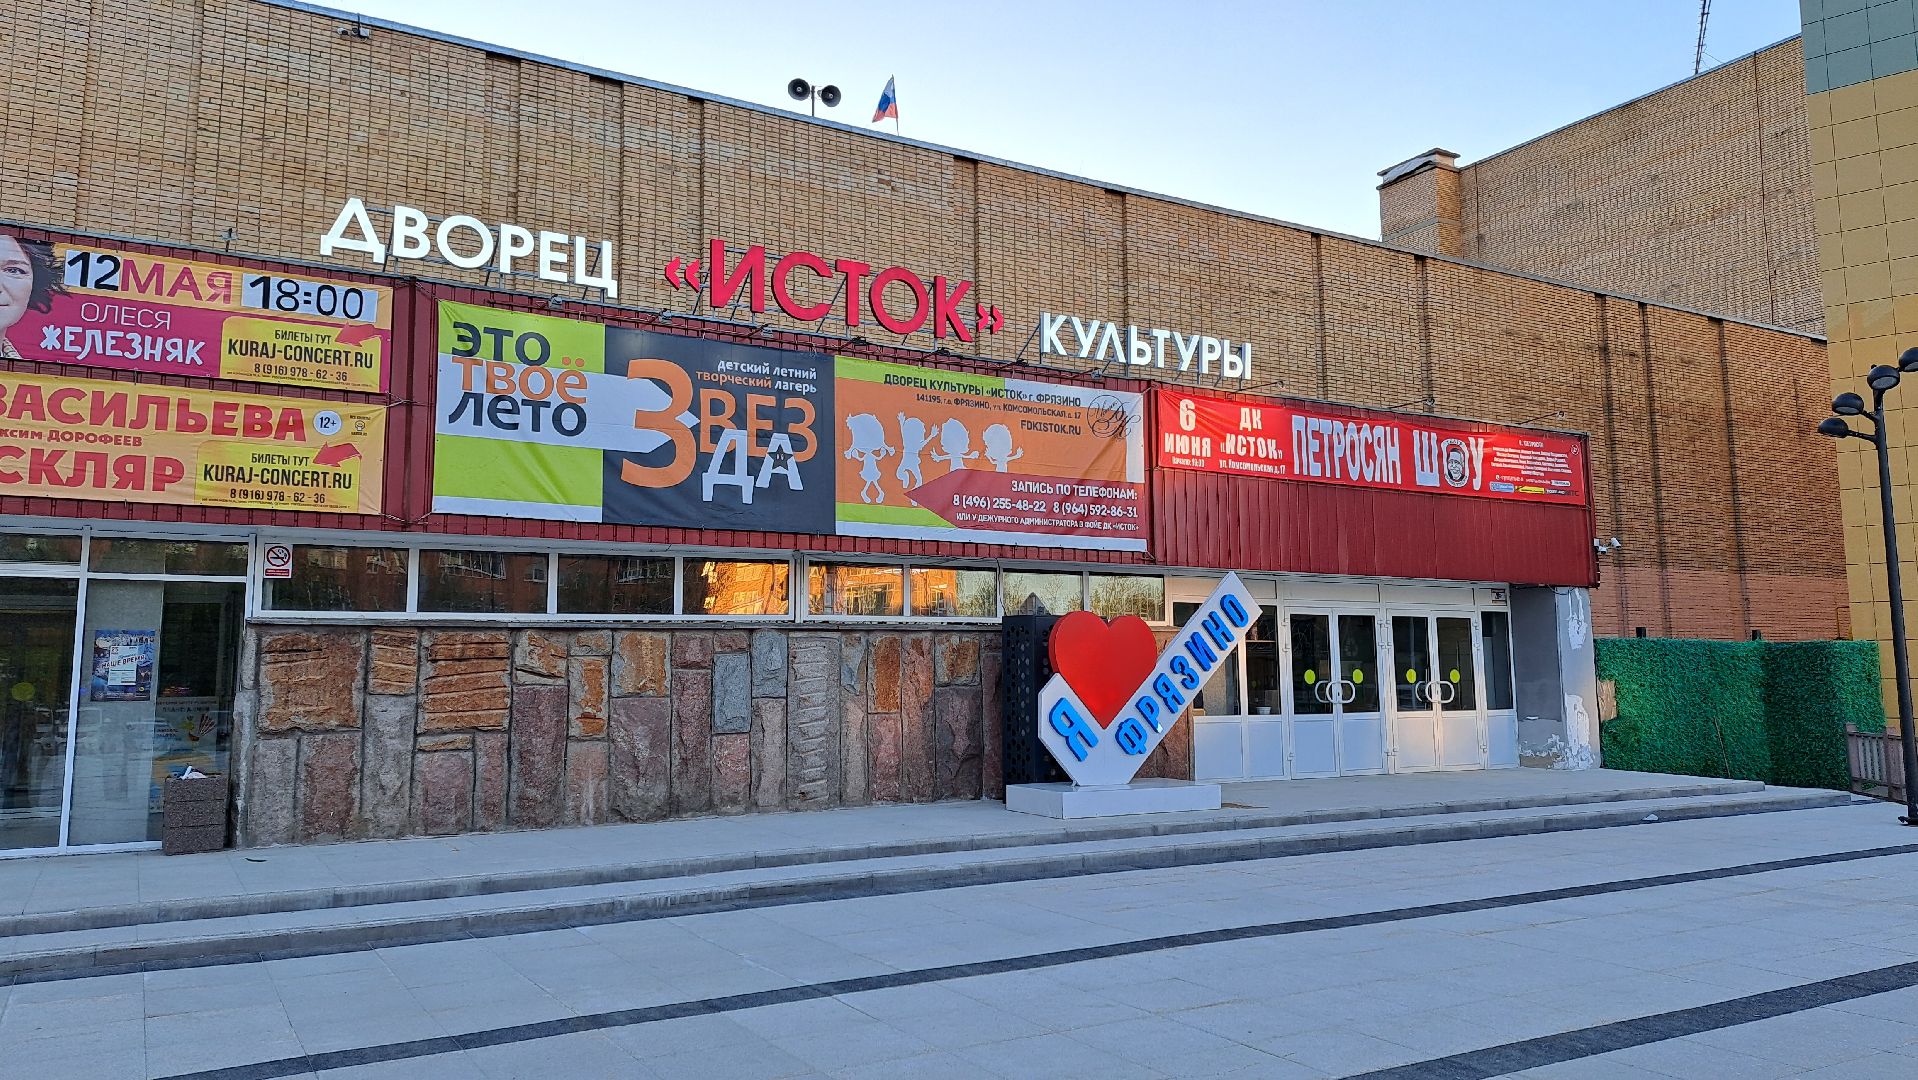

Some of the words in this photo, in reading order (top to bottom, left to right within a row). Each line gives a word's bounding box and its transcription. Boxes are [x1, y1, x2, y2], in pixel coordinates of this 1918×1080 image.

[67, 252, 121, 291] 12
[121, 259, 232, 304] МАЯ
[249, 275, 364, 319] 18:00
[320, 196, 618, 298] ДВОРЕЦ
[664, 239, 1004, 342] «ИСТОК»
[1040, 312, 1251, 379] КУЛЬТУРЫ
[81, 302, 171, 330] ОЛЕСЯ
[40, 325, 205, 365] ЖЕЛЕЗНЯК
[274, 329, 312, 343] БИЛЕТЫ
[315, 334, 331, 344] ТУТ
[228, 339, 373, 368] KURAJ-CONCERT.RU
[263, 364, 287, 376] (916)
[717, 360, 769, 375] детский
[772, 368, 817, 380] летний
[695, 371, 772, 389] творческий
[775, 380, 817, 395] лагерь
[884, 373, 927, 390] ДВОРЕЦ
[930, 379, 984, 396] КУЛЬТУРЫ
[986, 389, 1027, 401] «ИСТОК»
[1036, 393, 1081, 407] ФРЯЗИНО
[0, 383, 306, 441] АСИЛЬЕВА
[319, 417, 336, 428] 12+
[1180, 399, 1196, 431] 6
[1240, 407, 1262, 432] ДК
[47, 430, 142, 447] ДОРОФЕЕВ
[1020, 420, 1081, 435] FDKISTOK.RU
[1165, 432, 1212, 457] ИЮНЯ
[1292, 414, 1402, 484] ПЕТРОСЯН
[0, 446, 184, 491] СКЛЯР
[251, 453, 290, 465] БИЛЕТЫ
[293, 456, 309, 466] ТУТ
[1413, 430, 1484, 491] ШОУ
[204, 464, 352, 489] KURAJ-CONCERT.RU
[239, 489, 264, 501] (916)
[1011, 480, 1053, 494] ЗАПИСЬ
[1056, 483, 1071, 496] ПО
[1072, 485, 1138, 500] ТЕЛЕФОНАМ:
[953, 494, 959, 506] 8
[962, 495, 990, 511] (496)
[993, 498, 1046, 512] 255-48-22
[1053, 501, 1059, 512] 8
[1062, 501, 1088, 517] (964)
[1090, 505, 1138, 518] 592-86-31
[956, 512, 971, 521] ИЛИ
[978, 514, 1019, 524] ДЕЖУРНОГО
[1020, 517, 1078, 528] АДМИНИСТРАТОРА
[1085, 521, 1102, 530] ФОЙЕ
[1103, 522, 1112, 530] ДК
[1049, 697, 1099, 762] Я
[1115, 593, 1249, 755] ФРЯЗИНО
